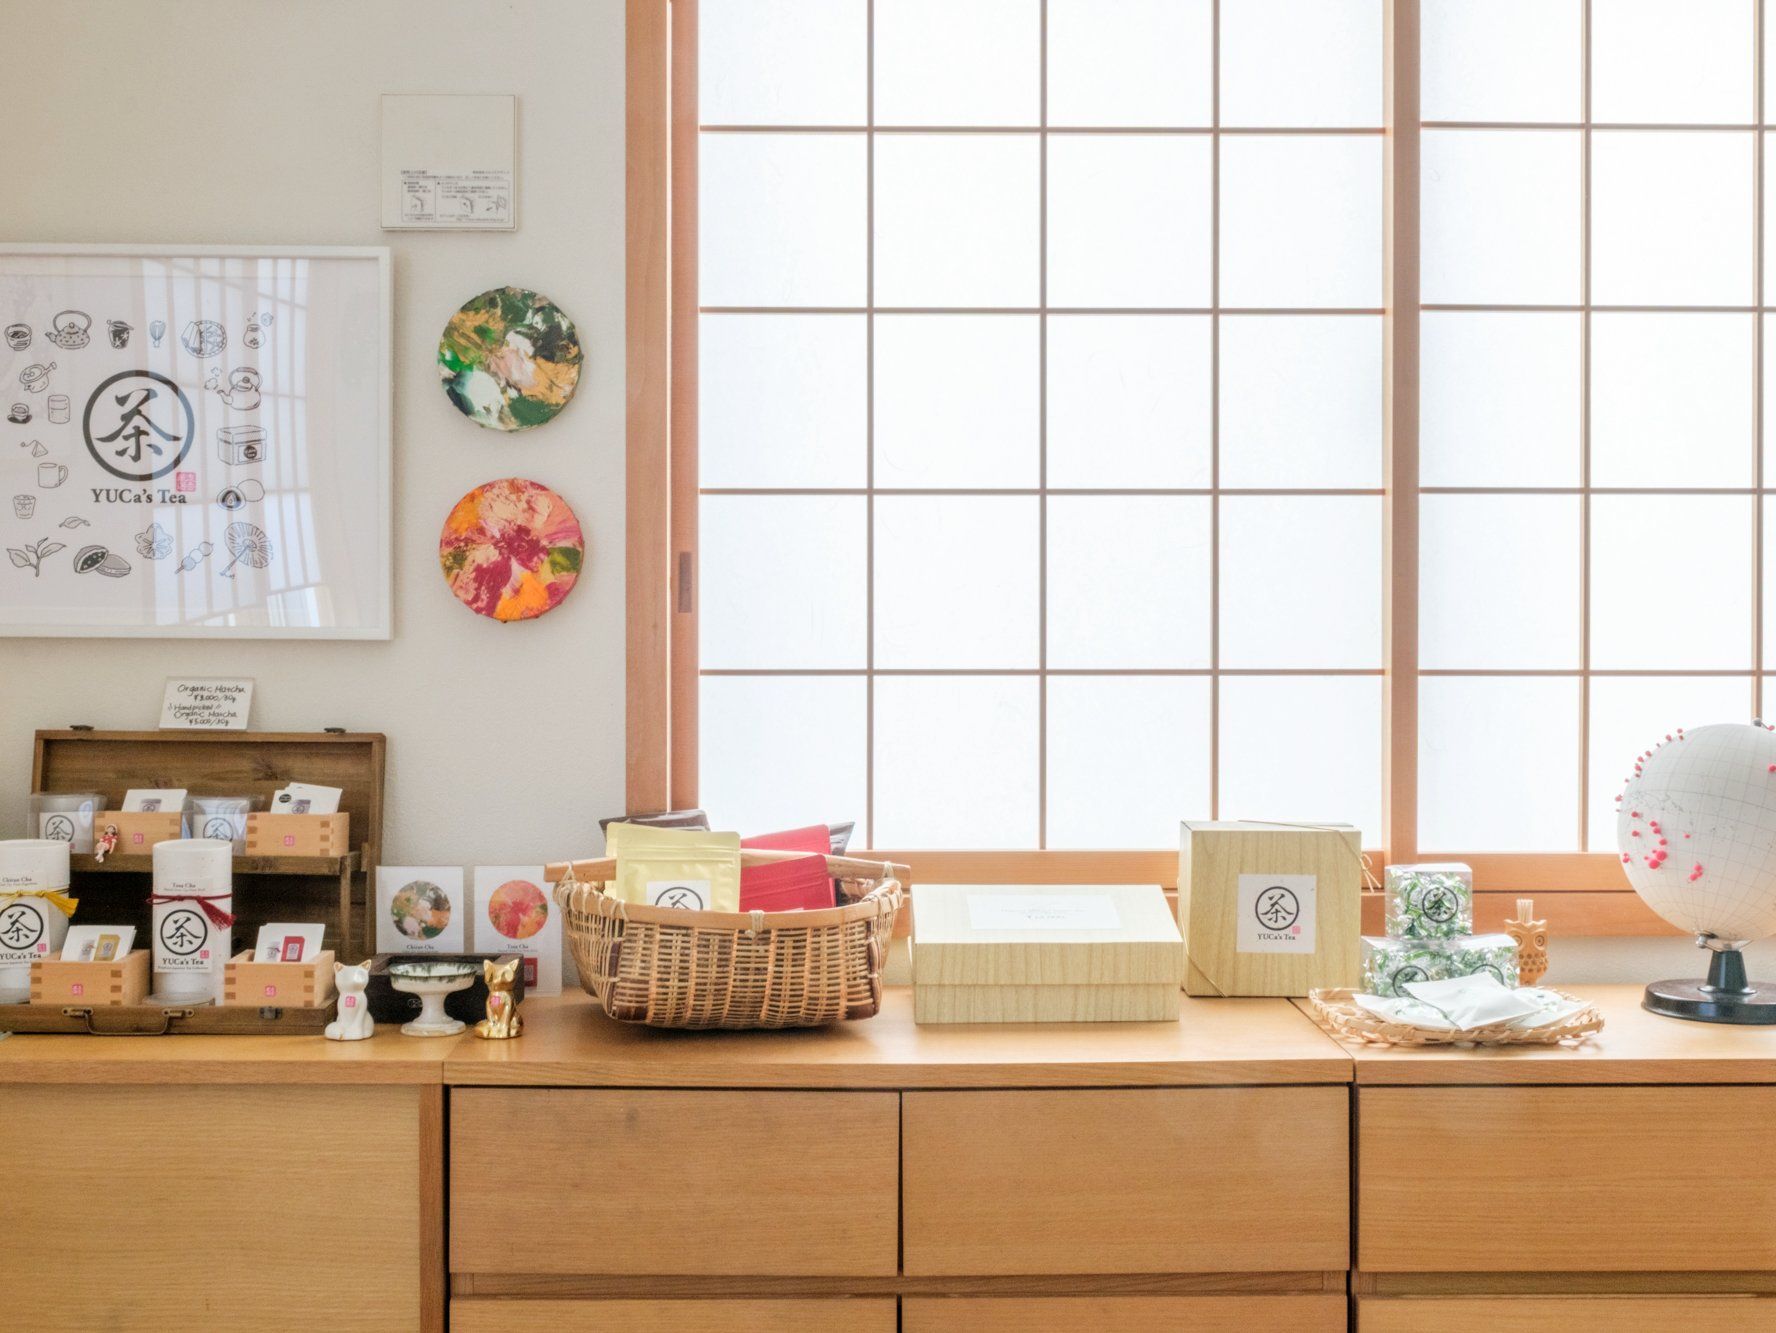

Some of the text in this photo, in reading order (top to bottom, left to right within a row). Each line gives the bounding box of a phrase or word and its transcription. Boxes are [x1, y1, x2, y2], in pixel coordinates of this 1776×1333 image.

[94, 388, 182, 463] 茶
[91, 488, 187, 504] YUCa's Tea
[177, 684, 246, 696] Organic Matcha
[173, 710, 238, 720] Organic Matcha
[1261, 893, 1294, 924] 茶
[1, 910, 38, 943] 茶
[165, 916, 202, 948] 茶
[1257, 933, 1297, 941] YUCa's Tea
[28, 952, 42, 960] Tea
[162, 957, 205, 966] YUCa's Tea
